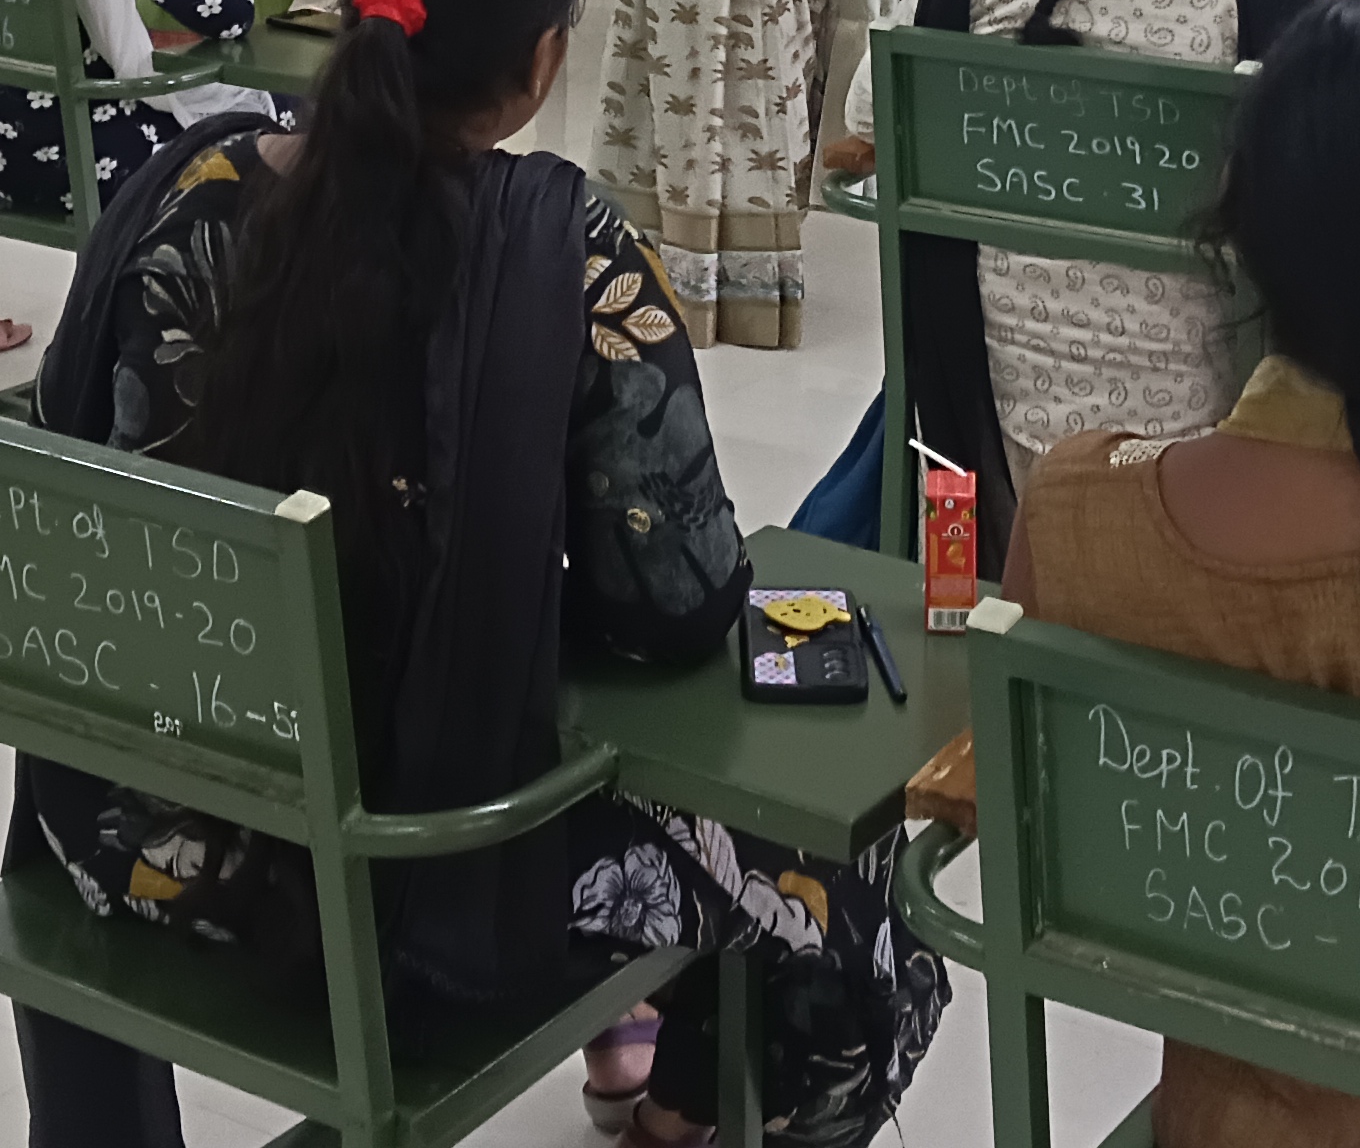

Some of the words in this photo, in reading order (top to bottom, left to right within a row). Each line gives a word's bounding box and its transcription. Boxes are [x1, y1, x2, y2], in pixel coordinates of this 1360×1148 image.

[962, 112, 1045, 150] FMC
[1100, 90, 1180, 125] TSD
[976, 158, 1083, 203] SASC
[1121, 182, 1160, 212] 31
[130, 518, 240, 583] TSD
[1121, 798, 1228, 863] FMC
[1146, 865, 1291, 951] SASC
